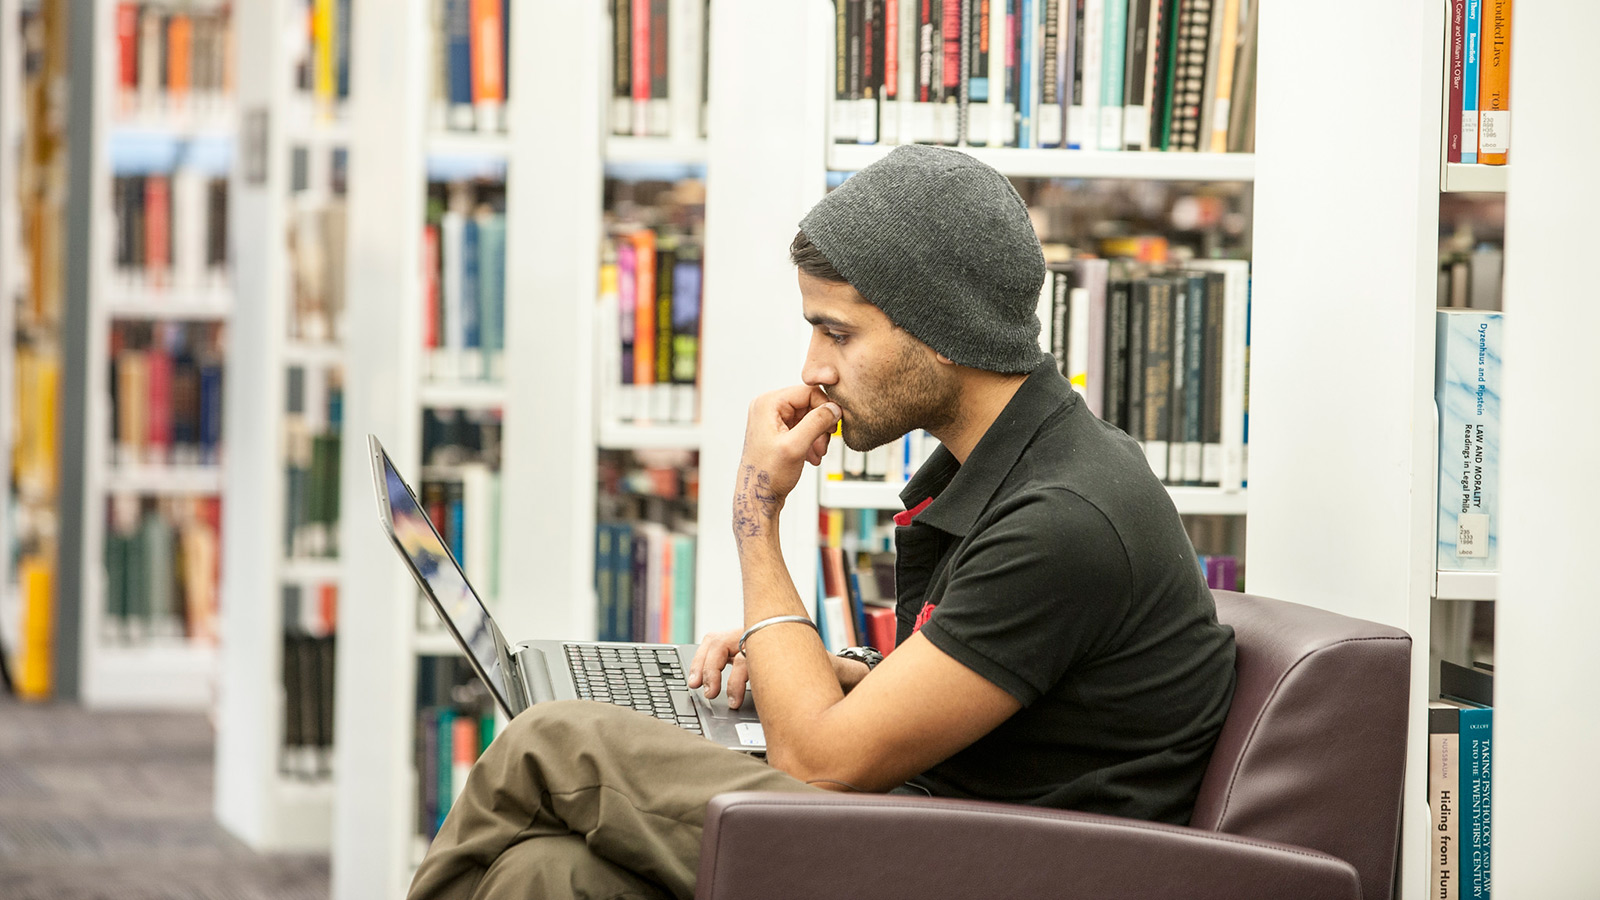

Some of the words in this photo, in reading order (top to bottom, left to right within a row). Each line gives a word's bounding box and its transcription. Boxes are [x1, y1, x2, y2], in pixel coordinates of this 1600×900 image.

[1455, 3, 1463, 25] Conley
[1469, 2, 1477, 20] Theory
[1493, 41, 1504, 67] Lives
[1478, 323, 1488, 365] Dyzenhaus
[1478, 367, 1486, 382] and
[1475, 384, 1486, 416] Ripstein
[1462, 424, 1472, 459] Readings
[1461, 471, 1470, 491] Legal
[1473, 465, 1482, 508] MORALITY
[1462, 493, 1470, 513] Philo
[1482, 739, 1490, 779] TAKING
[1438, 790, 1451, 831] Hiding
[1473, 778, 1481, 849] TWENTY-FIRST
[1482, 780, 1490, 848] PSYCHOLOGY
[1440, 836, 1451, 865] from
[1440, 870, 1450, 899] Hum
[1473, 851, 1481, 898] CENTURY
[1483, 870, 1491, 893] LAW
